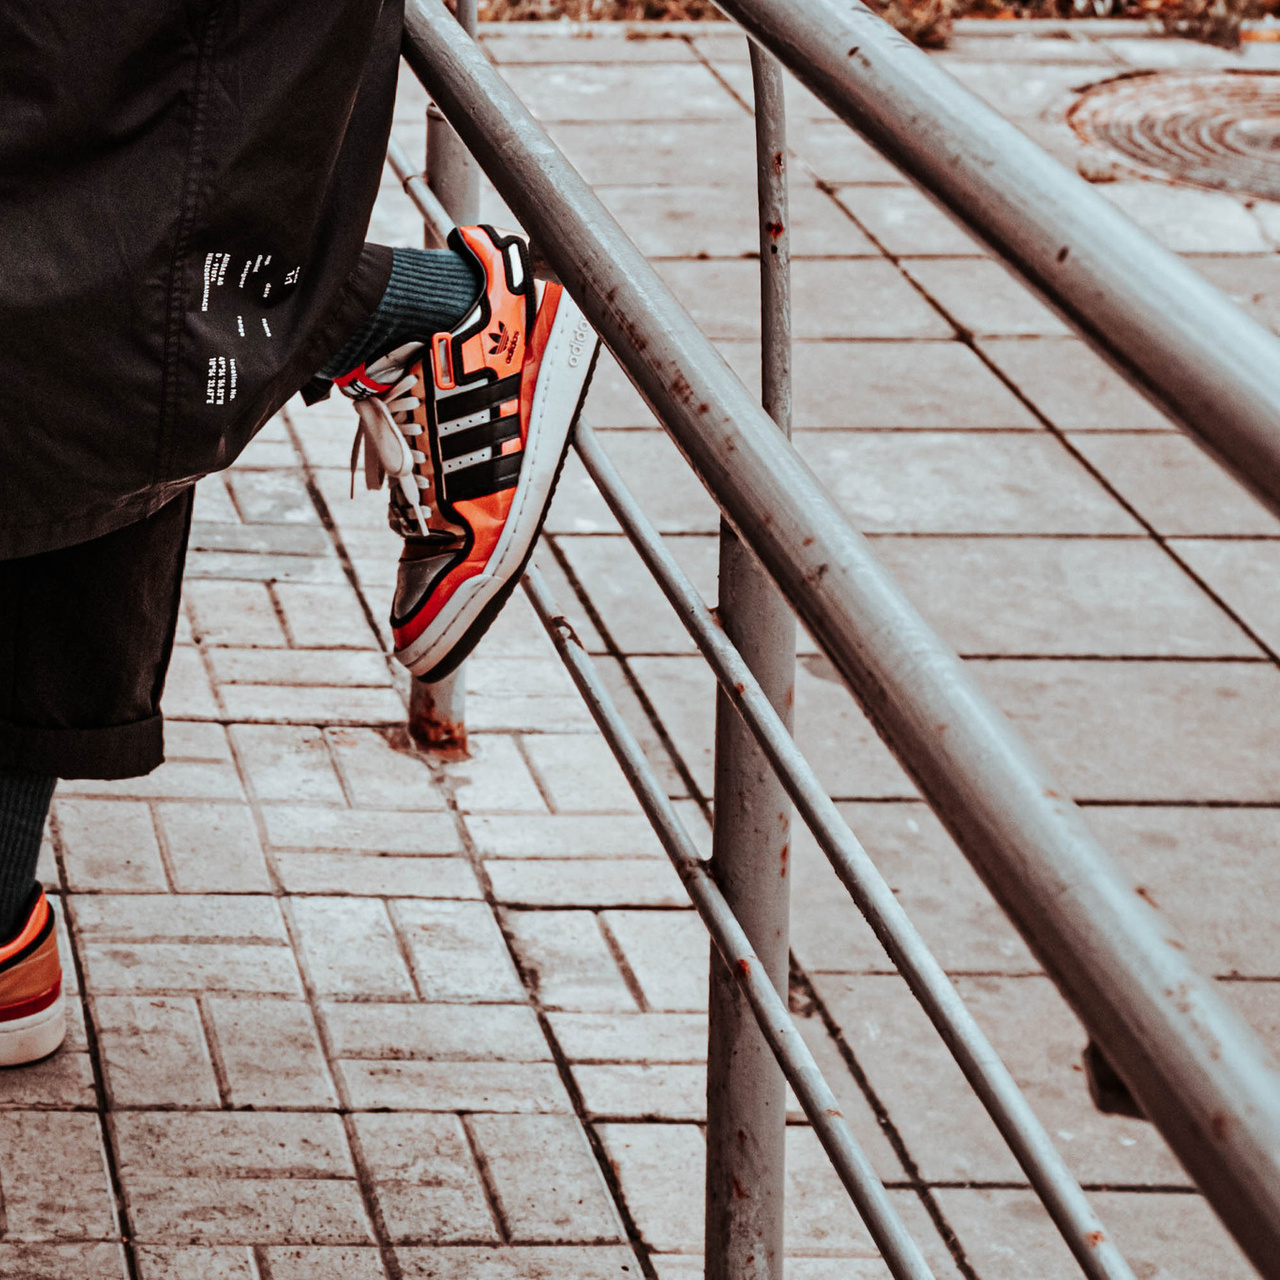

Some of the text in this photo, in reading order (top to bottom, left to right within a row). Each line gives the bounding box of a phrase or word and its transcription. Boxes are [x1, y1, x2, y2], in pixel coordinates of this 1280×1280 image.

[201, 252, 215, 312] HERZOGENAURACH
[216, 253, 231, 286] ADIDAS AG
[263, 282, 272, 298] date
[261, 317, 272, 338] name
[506, 331, 519, 364] adidas
